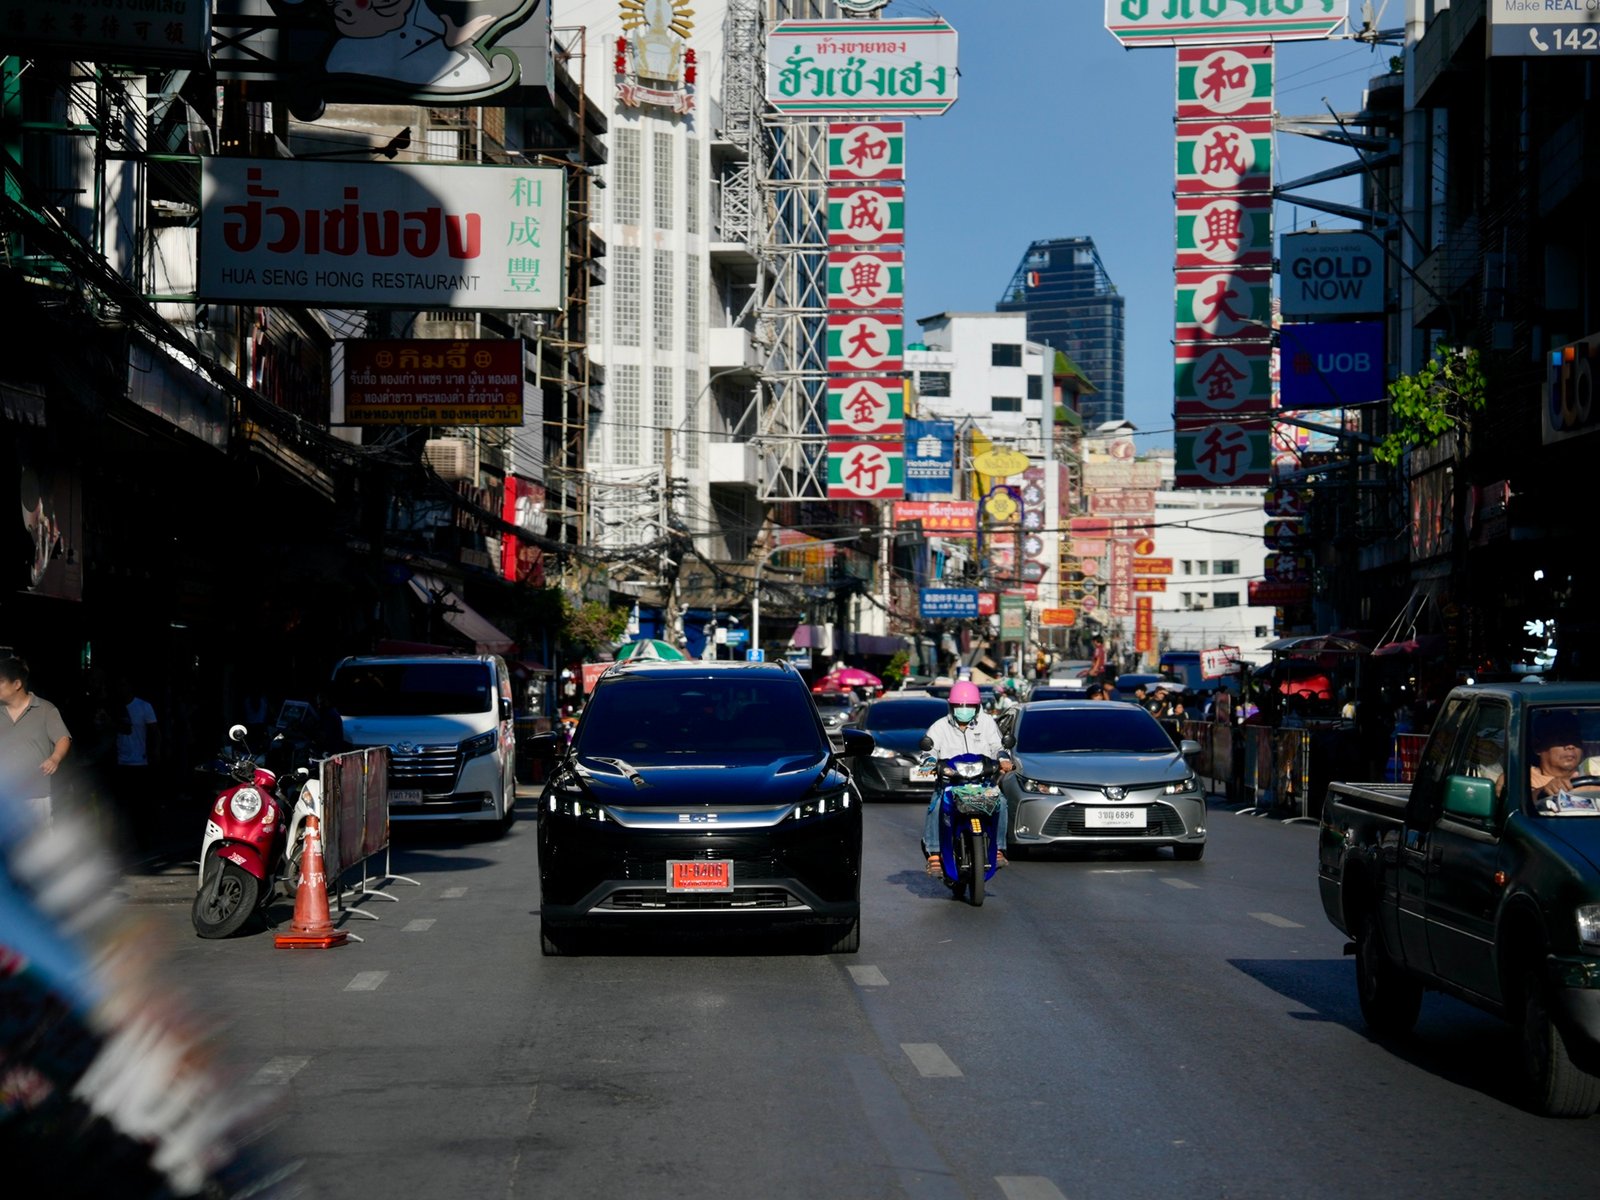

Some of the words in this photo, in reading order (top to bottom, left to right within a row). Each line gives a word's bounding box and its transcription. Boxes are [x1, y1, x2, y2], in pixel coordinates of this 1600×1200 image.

[1505, 0, 1540, 11] Make
[1544, 0, 1582, 11] REAL
[816, 38, 907, 54] ห้างขายทอง
[1552, 28, 1600, 50] 142
[778, 45, 946, 97] ฮั่วเซ่งเฮง
[223, 168, 481, 259] ฮั่วเซ่งฮง
[504, 176, 543, 294] 和成豐
[1196, 56, 1250, 477] 和成興大金行
[1292, 256, 1372, 280] GOLD
[221, 268, 256, 284] HUA
[262, 269, 308, 286] SENG
[315, 271, 364, 288] HONG
[372, 273, 480, 291] RESTAURANT
[1302, 280, 1363, 301] NOW
[845, 132, 888, 490] 和成興大金行
[1316, 352, 1371, 373] UOB
[1115, 811, 1135, 819] 6896
